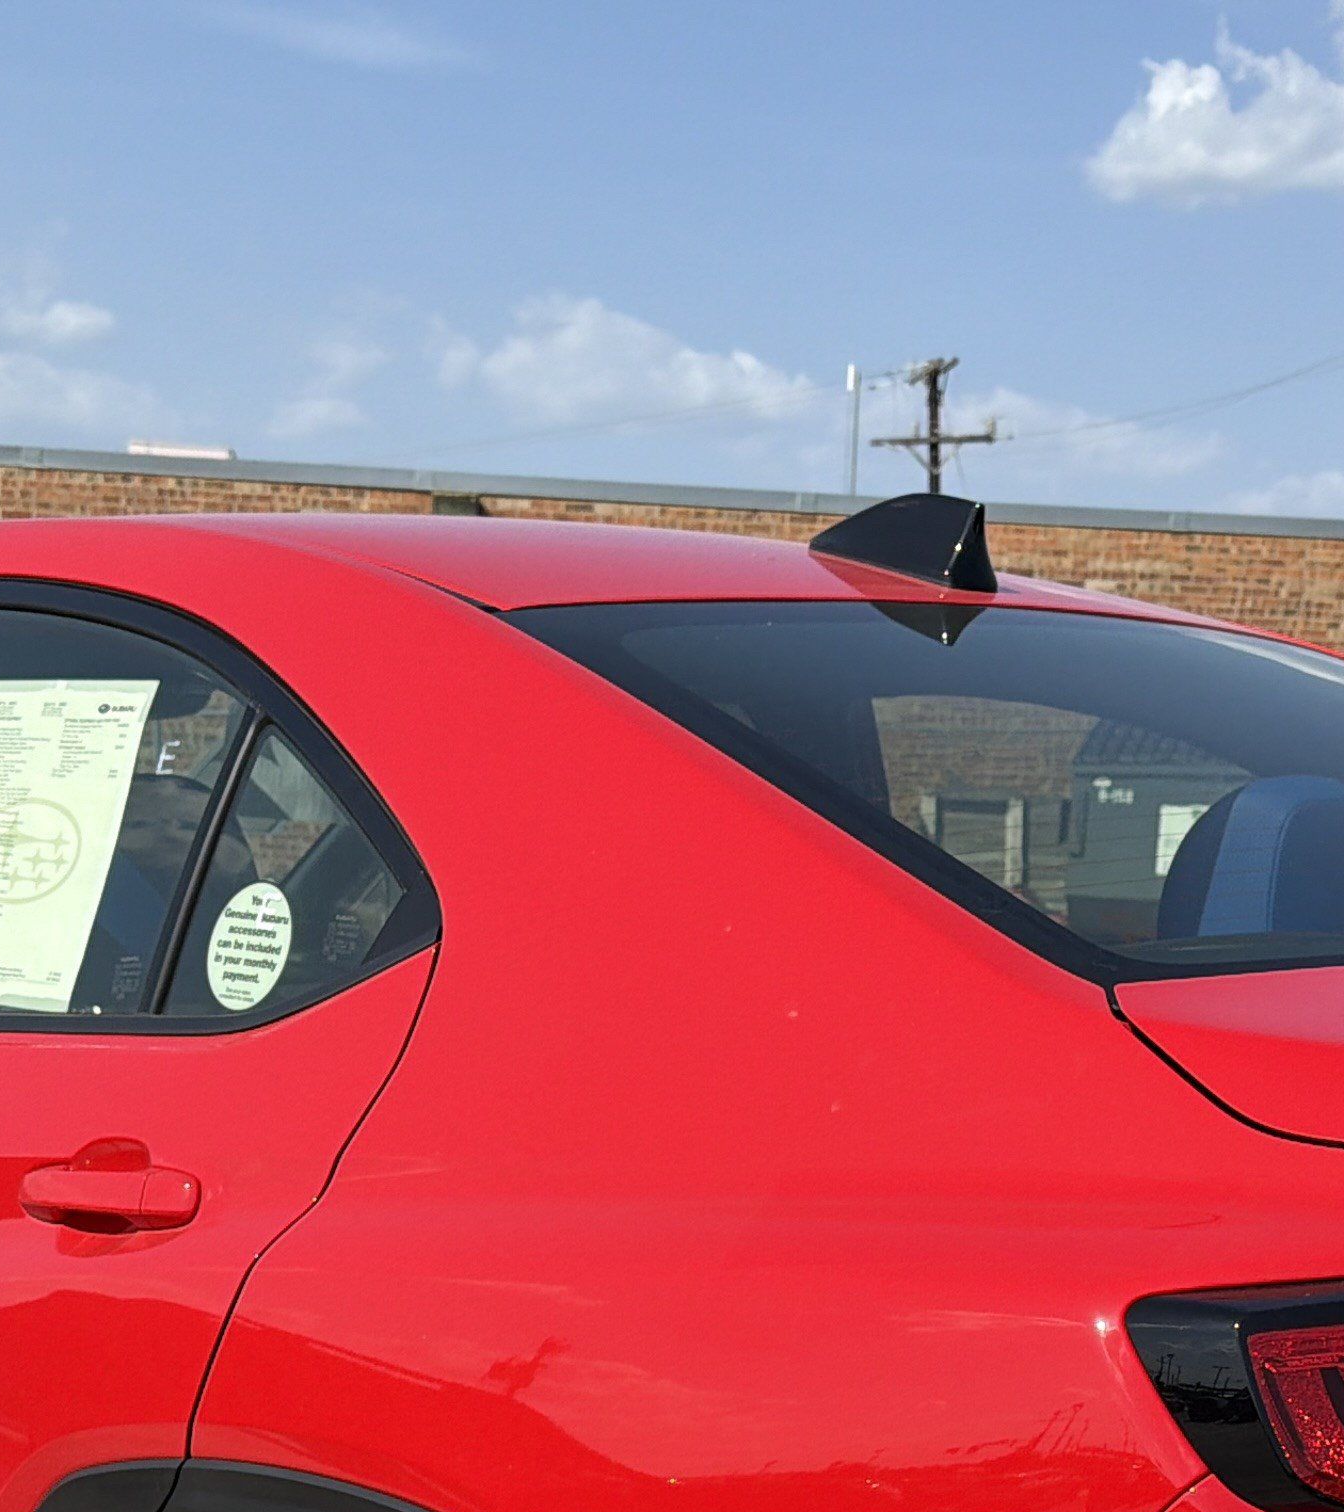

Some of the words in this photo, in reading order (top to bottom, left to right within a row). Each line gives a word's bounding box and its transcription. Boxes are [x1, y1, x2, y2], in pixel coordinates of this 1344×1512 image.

[225, 908, 258, 921] Genuine
[228, 925, 277, 939] accessories
[217, 939, 232, 949] can
[233, 939, 244, 950] be
[245, 942, 282, 956] included
[214, 951, 222, 962] in
[223, 955, 242, 966] your
[243, 958, 278, 972] monthly
[222, 970, 260, 984] payment.
